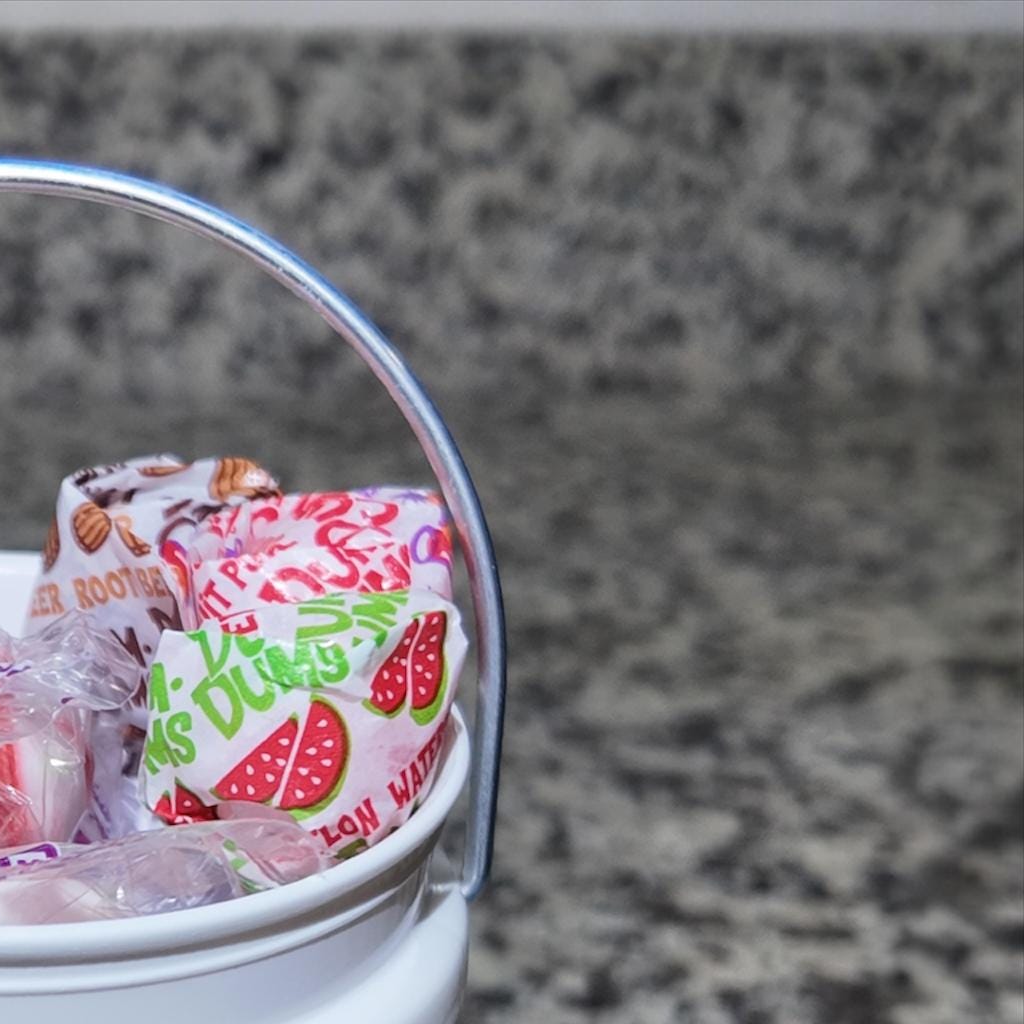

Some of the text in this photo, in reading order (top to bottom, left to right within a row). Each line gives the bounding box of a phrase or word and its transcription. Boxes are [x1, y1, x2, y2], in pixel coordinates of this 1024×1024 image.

[73, 566, 139, 610] ROOT
[190, 641, 350, 741] DUMS
[312, 797, 381, 848] LON
